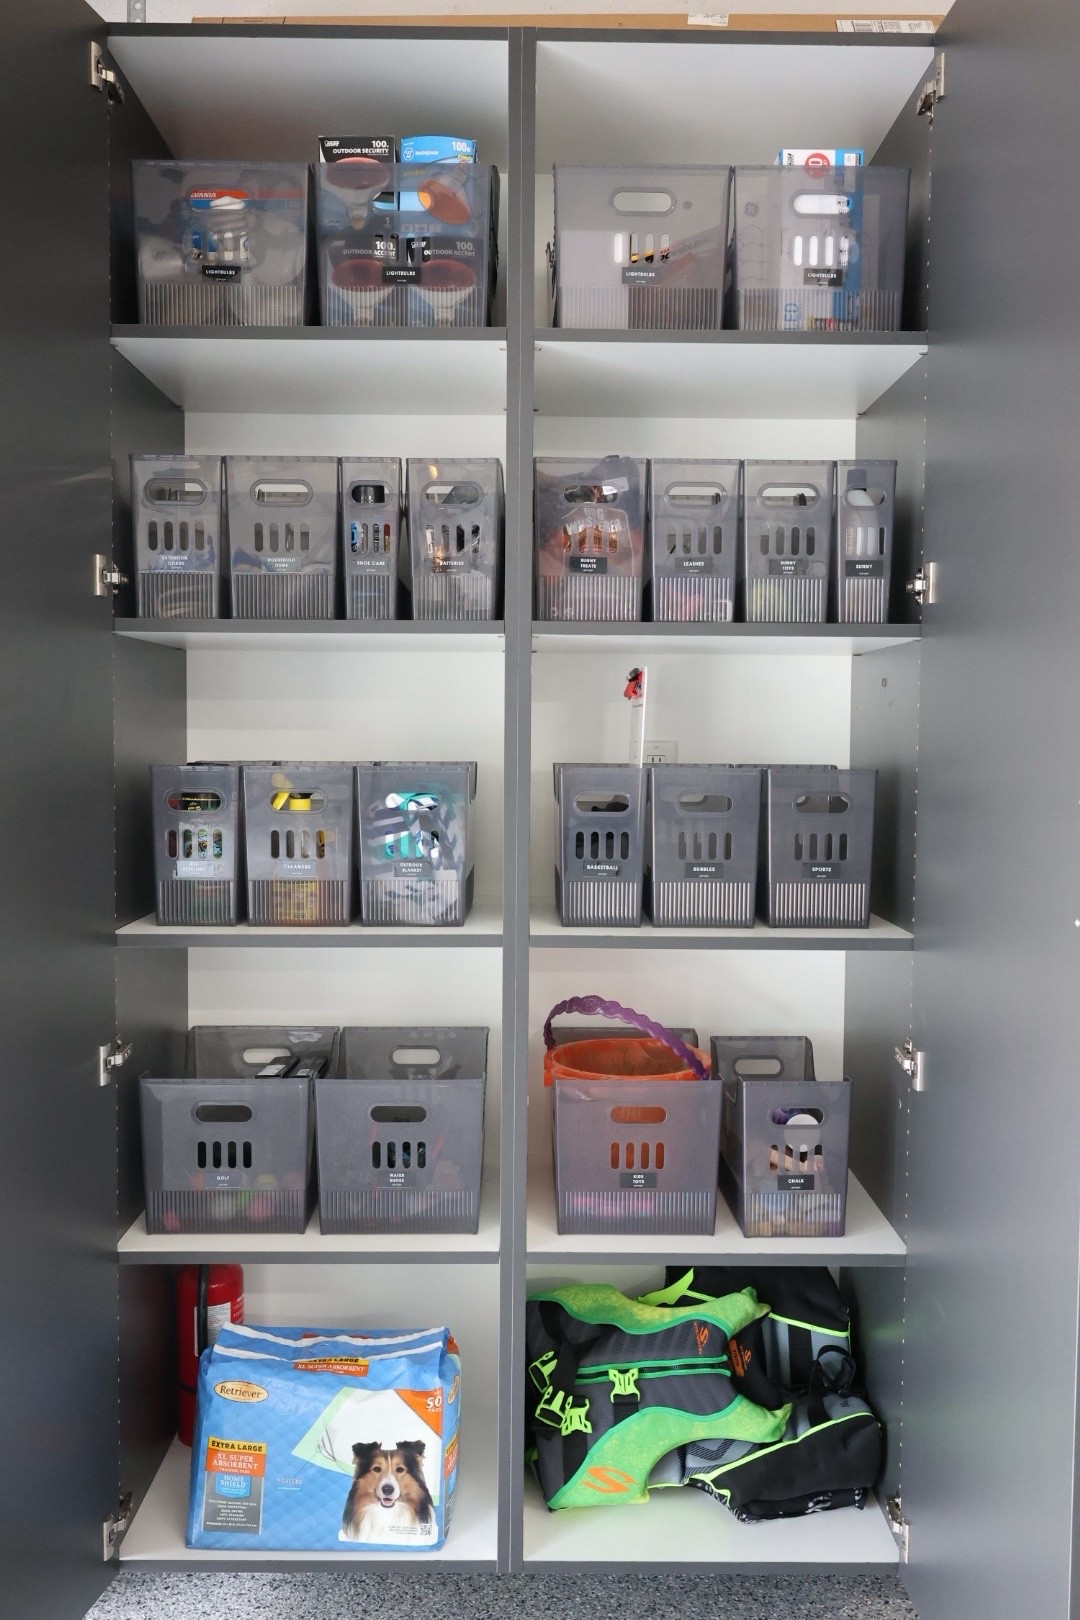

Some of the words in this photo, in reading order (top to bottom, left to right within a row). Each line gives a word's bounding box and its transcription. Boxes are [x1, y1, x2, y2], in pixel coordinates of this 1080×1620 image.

[328, 1363, 365, 1372] ABSORBENT
[219, 1385, 261, 1399] Retriever
[426, 1396, 442, 1409] 50
[211, 1440, 235, 1450] EXTRA
[237, 1443, 263, 1452] LARGE
[229, 1454, 254, 1463] SUPER
[212, 1460, 259, 1470] ABSORBENT
[223, 1474, 245, 1482] HOME
[220, 1480, 246, 1488] SHIELD
